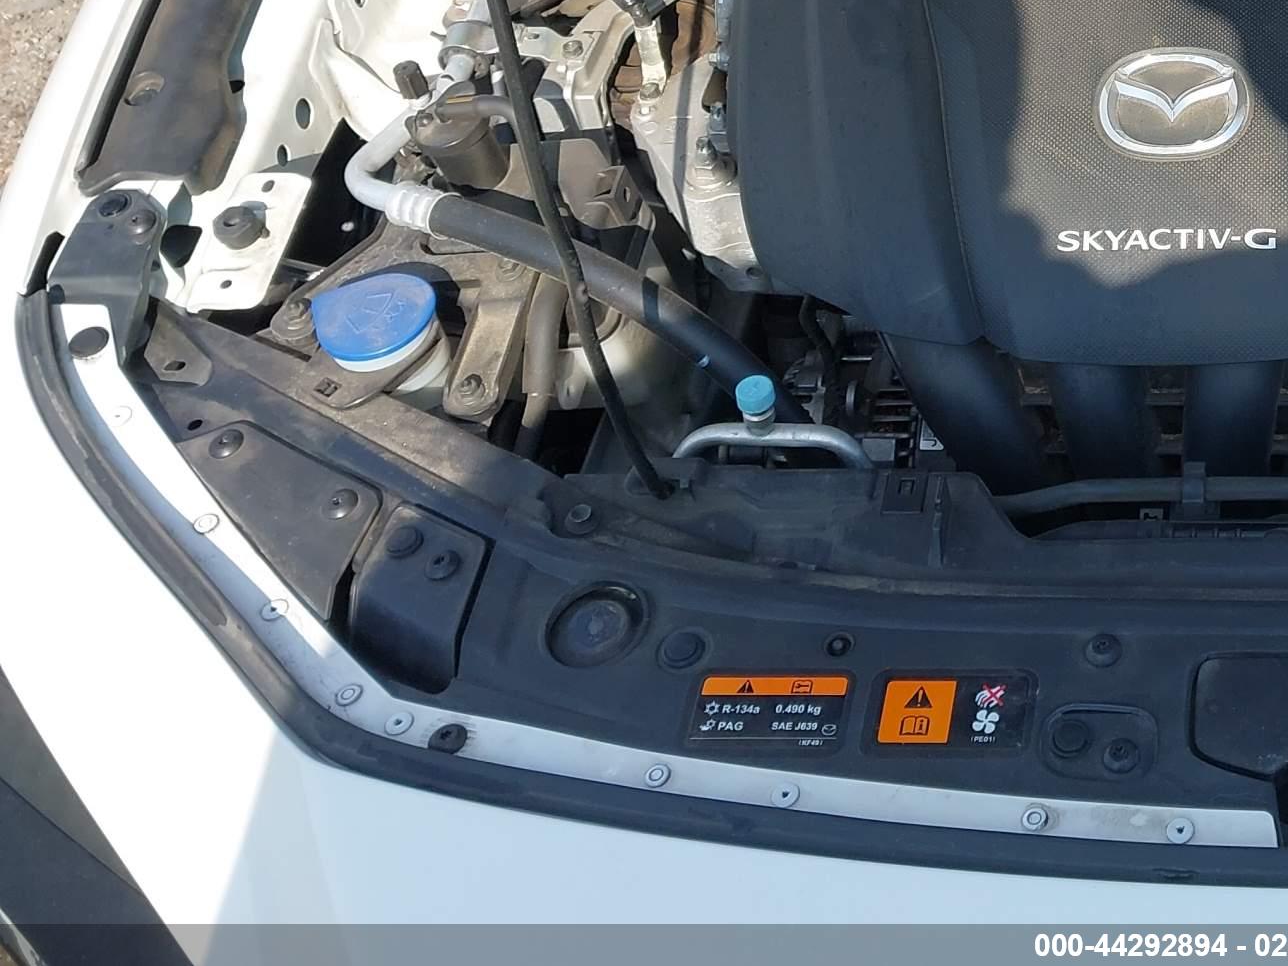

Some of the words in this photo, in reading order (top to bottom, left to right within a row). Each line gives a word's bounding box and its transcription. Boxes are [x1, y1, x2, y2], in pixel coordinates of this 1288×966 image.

[1056, 228, 1278, 252] SKYACTIV-G
[722, 703, 760, 715] R-134a
[775, 703, 805, 715] 0.490
[807, 704, 822, 717] kg
[717, 721, 744, 732] PAG
[771, 721, 792, 731] SAE
[794, 721, 818, 732] J639
